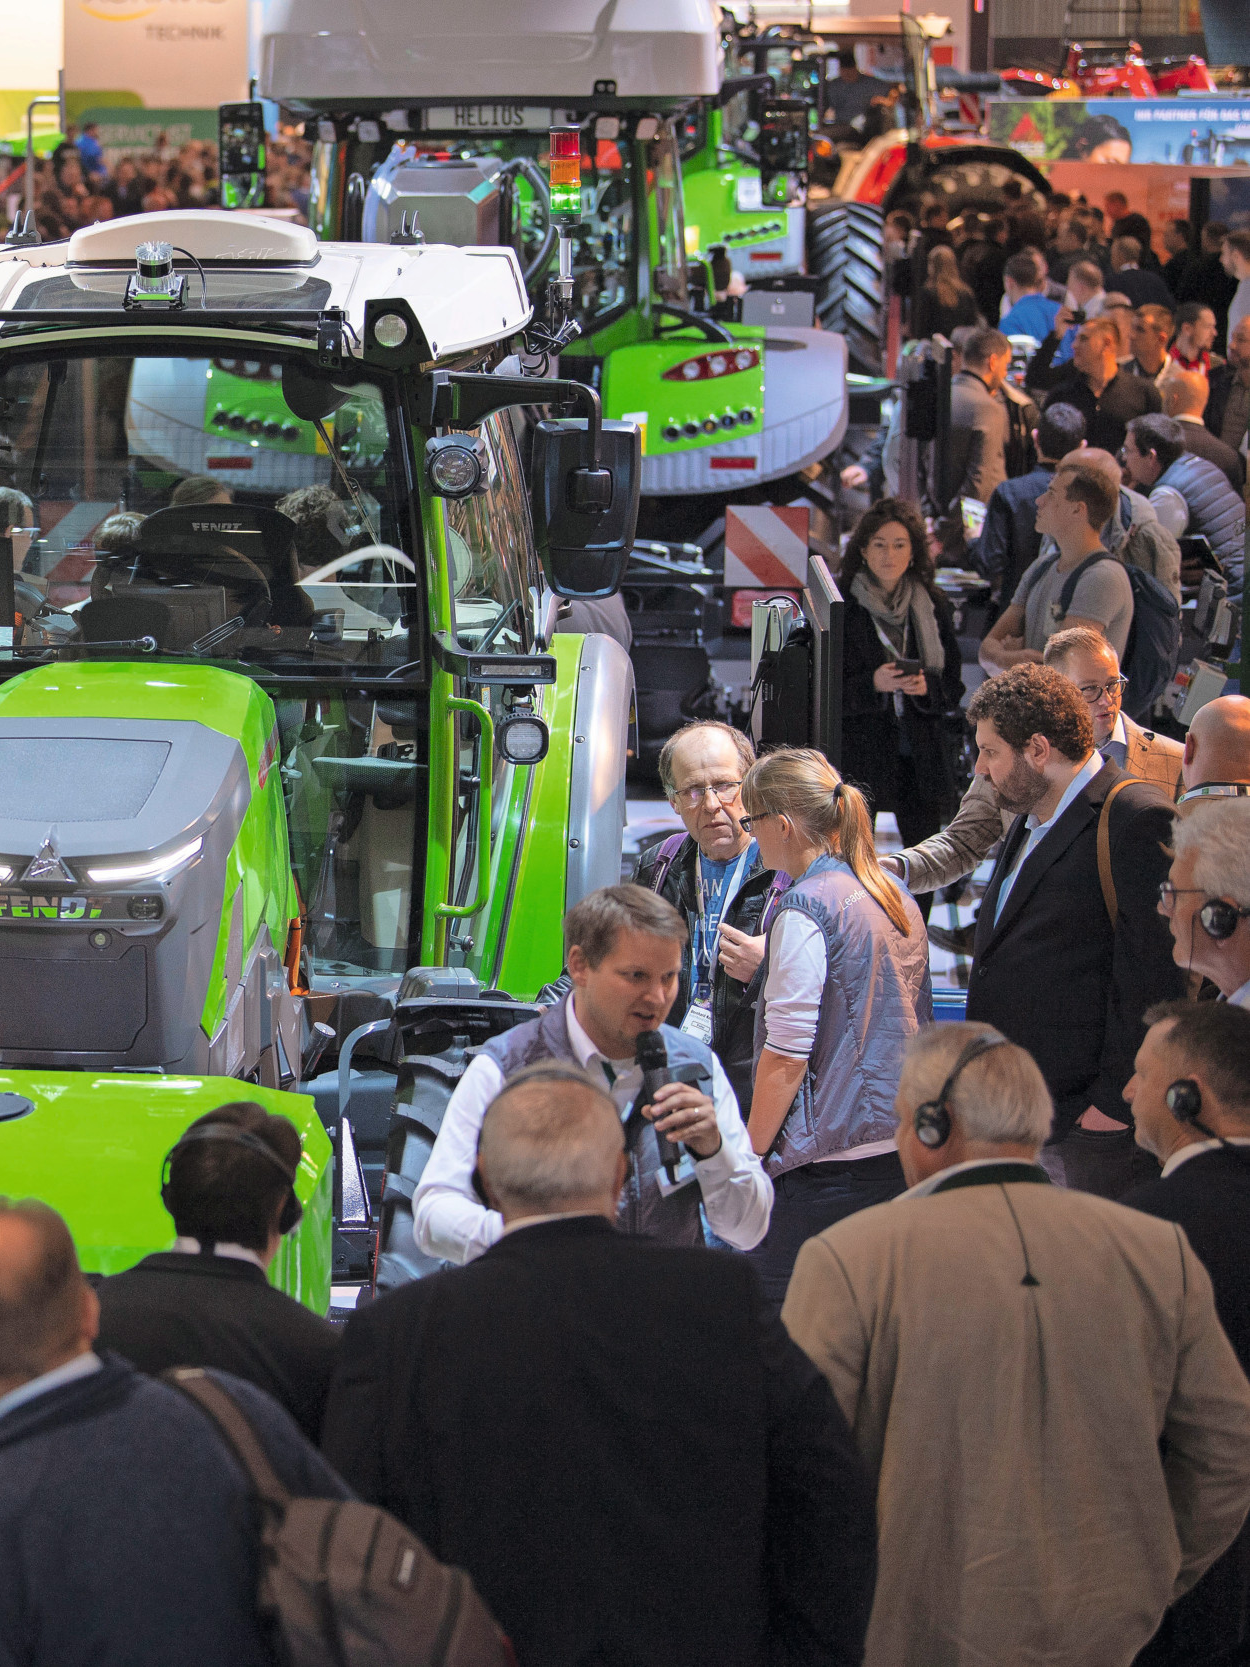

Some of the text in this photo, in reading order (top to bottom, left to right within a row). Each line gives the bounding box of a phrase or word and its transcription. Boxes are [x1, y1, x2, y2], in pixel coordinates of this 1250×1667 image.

[145, 24, 225, 41] TECHNIK
[454, 105, 525, 126] HELIOS
[192, 522, 242, 532] FENDT
